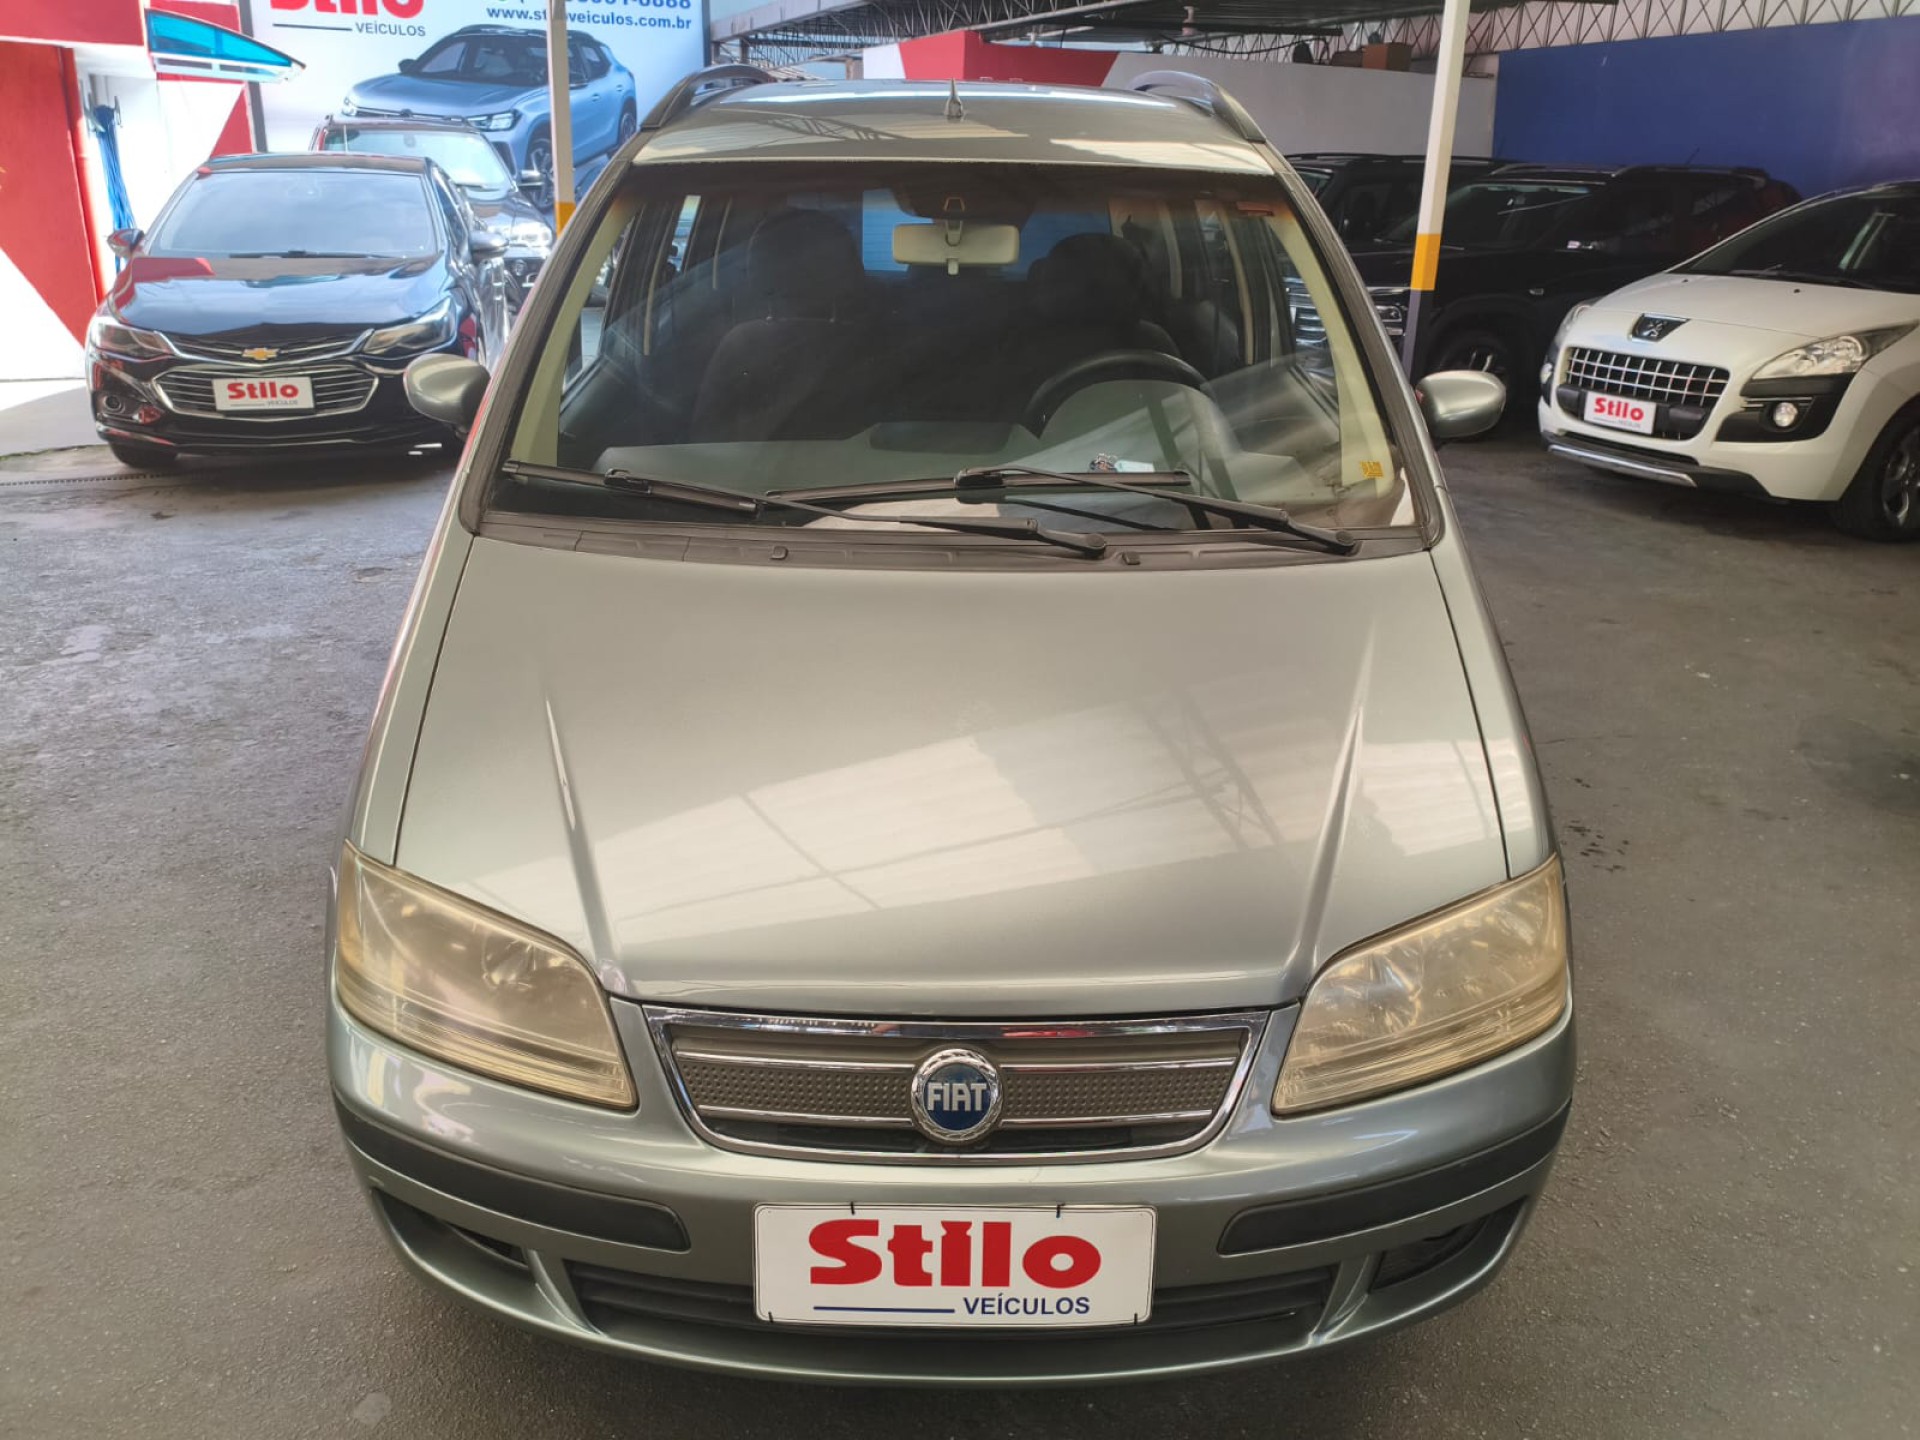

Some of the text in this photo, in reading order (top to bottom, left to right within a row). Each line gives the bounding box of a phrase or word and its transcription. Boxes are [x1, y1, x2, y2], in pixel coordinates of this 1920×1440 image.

[354, 22, 426, 36] VEÍCULOS
[486, 8, 692, 29] www.stveiculos.com.br
[227, 381, 299, 399] Stilo
[1594, 397, 1644, 421] Stilo
[926, 1082, 987, 1111] FIAT
[808, 1218, 1101, 1289] Stilo
[963, 1292, 1090, 1316] VEÍCULOS
